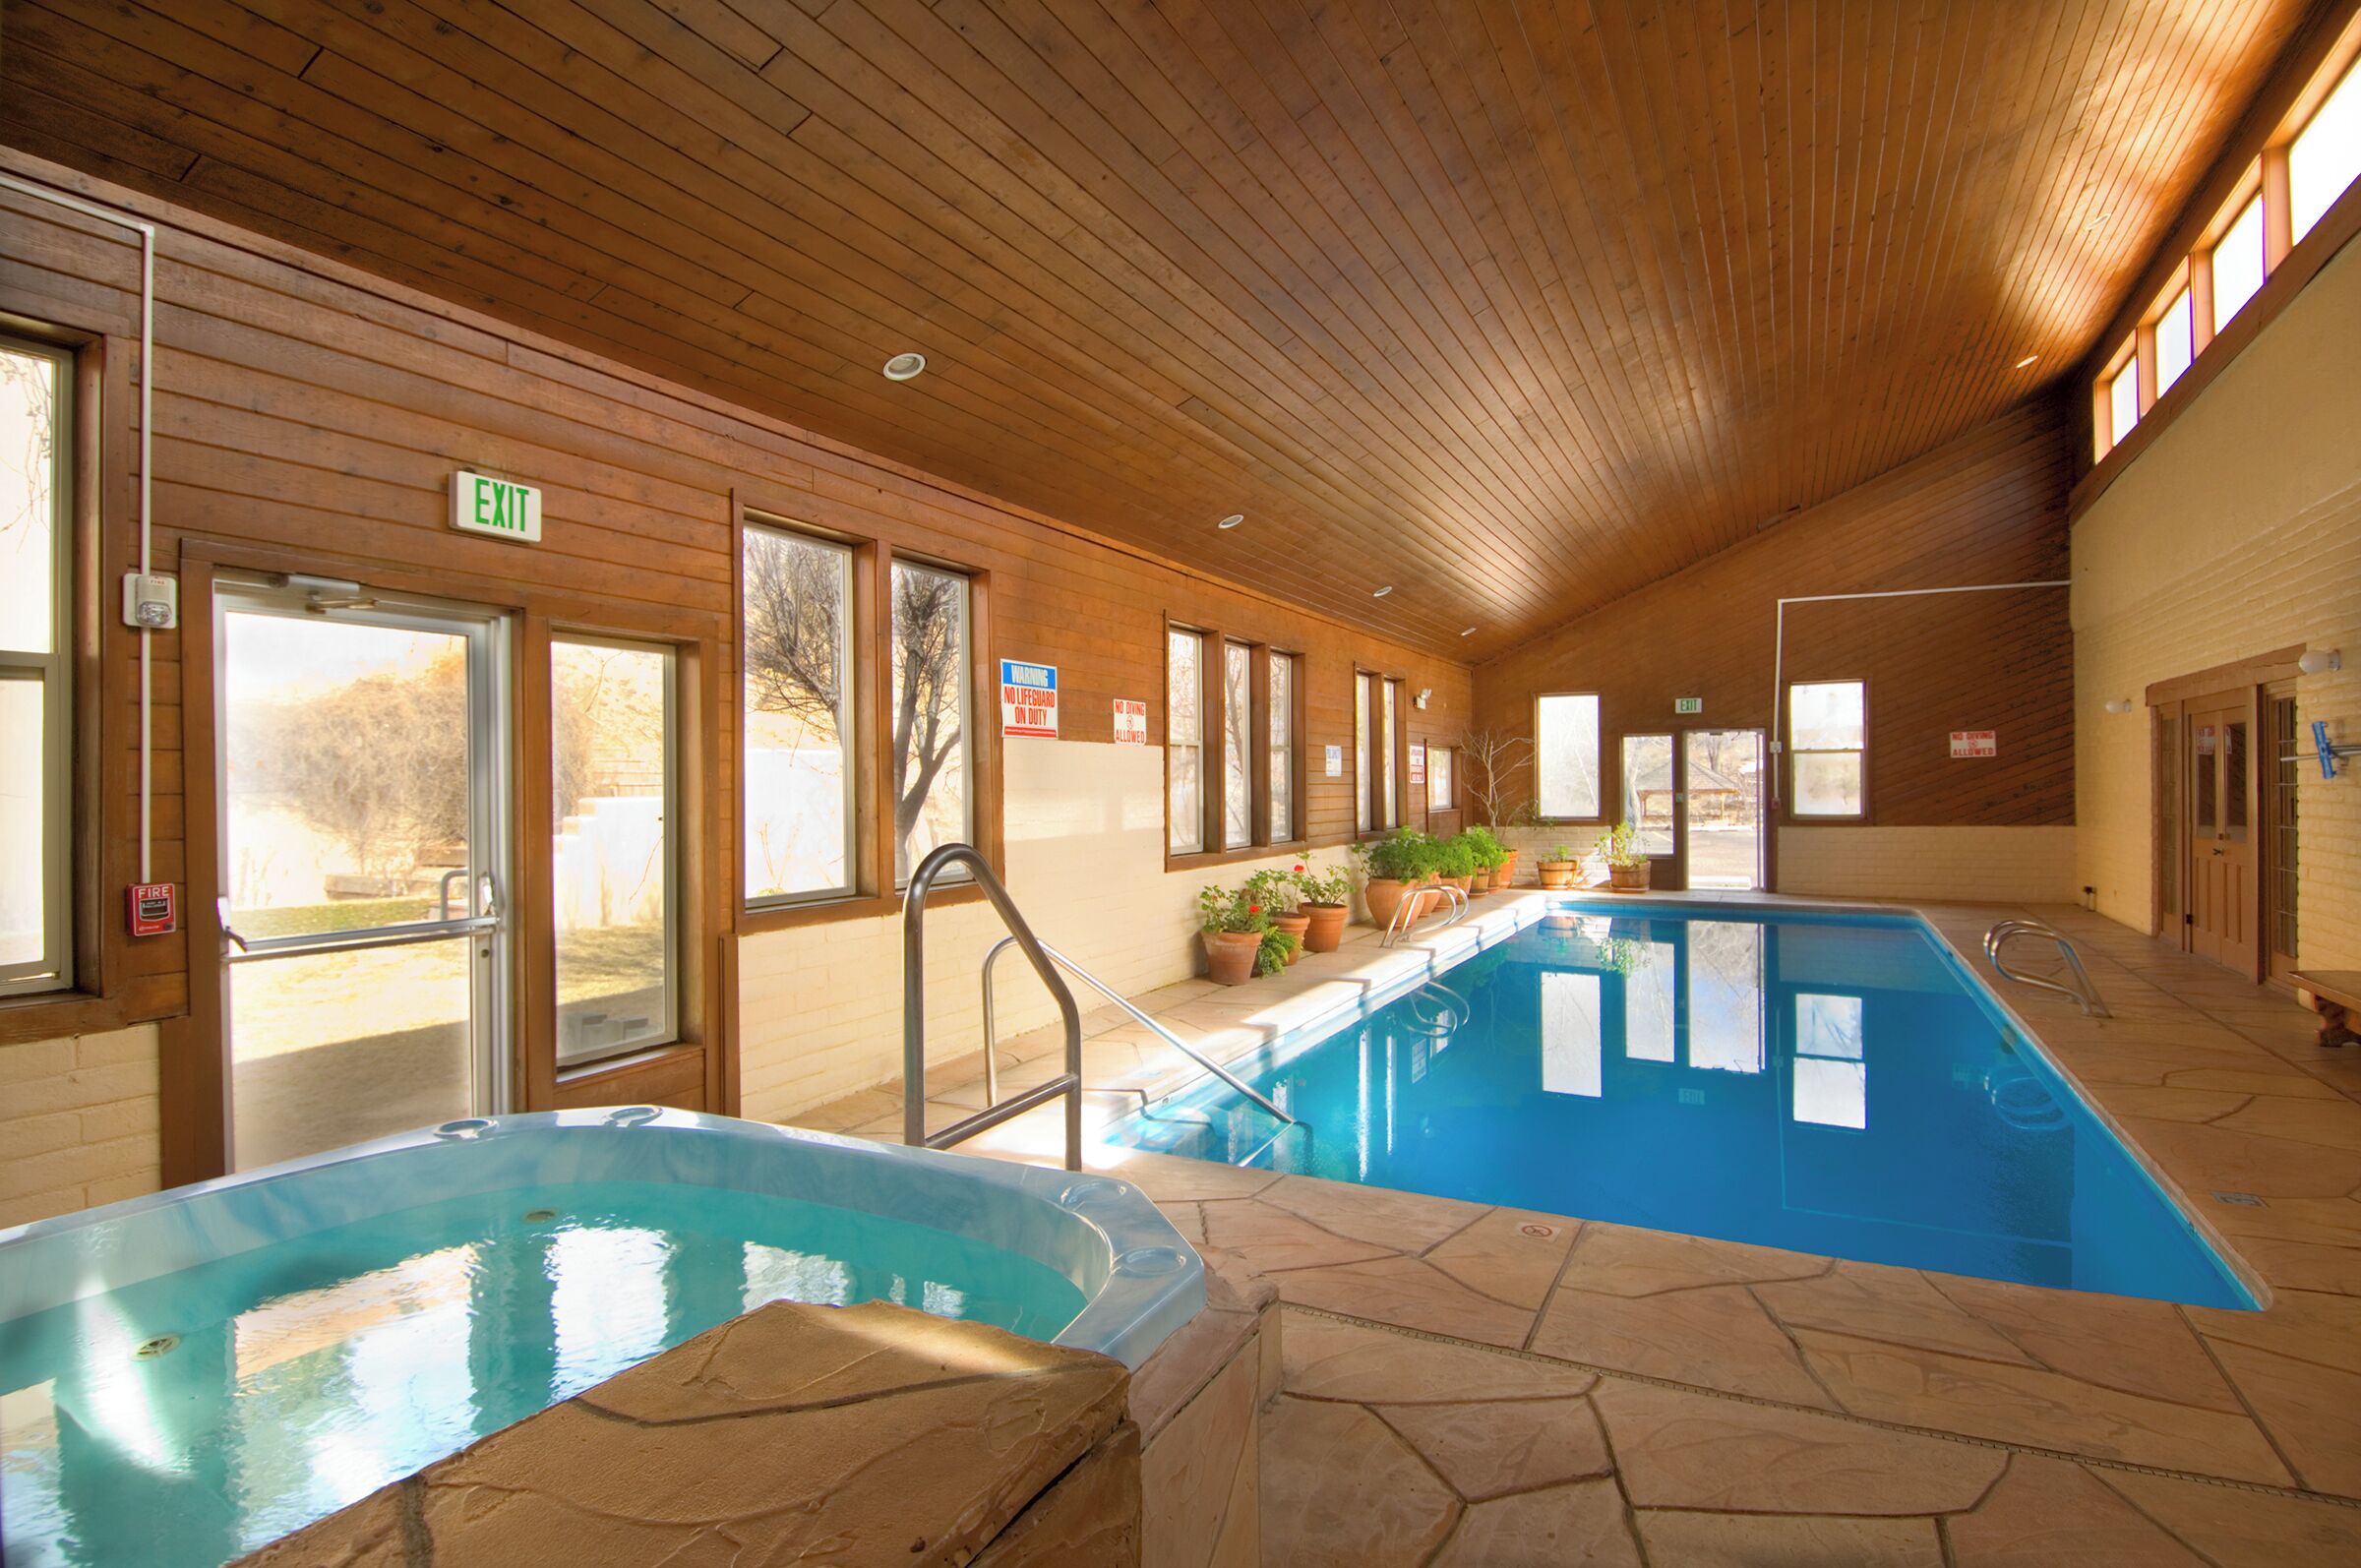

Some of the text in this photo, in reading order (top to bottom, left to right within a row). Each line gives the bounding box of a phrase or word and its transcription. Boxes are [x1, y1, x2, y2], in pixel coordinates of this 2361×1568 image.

[474, 478, 529, 532] EXIT
[1011, 664, 1049, 688] WARNING
[1004, 686, 1055, 708] NO LIFEGUARD
[1680, 699, 1697, 711] EXIT
[1014, 706, 1047, 726] ON DUTY
[1115, 700, 1144, 716] NO DIVING
[1116, 729, 1144, 744] ALLOWED
[138, 886, 169, 899] FIRE
